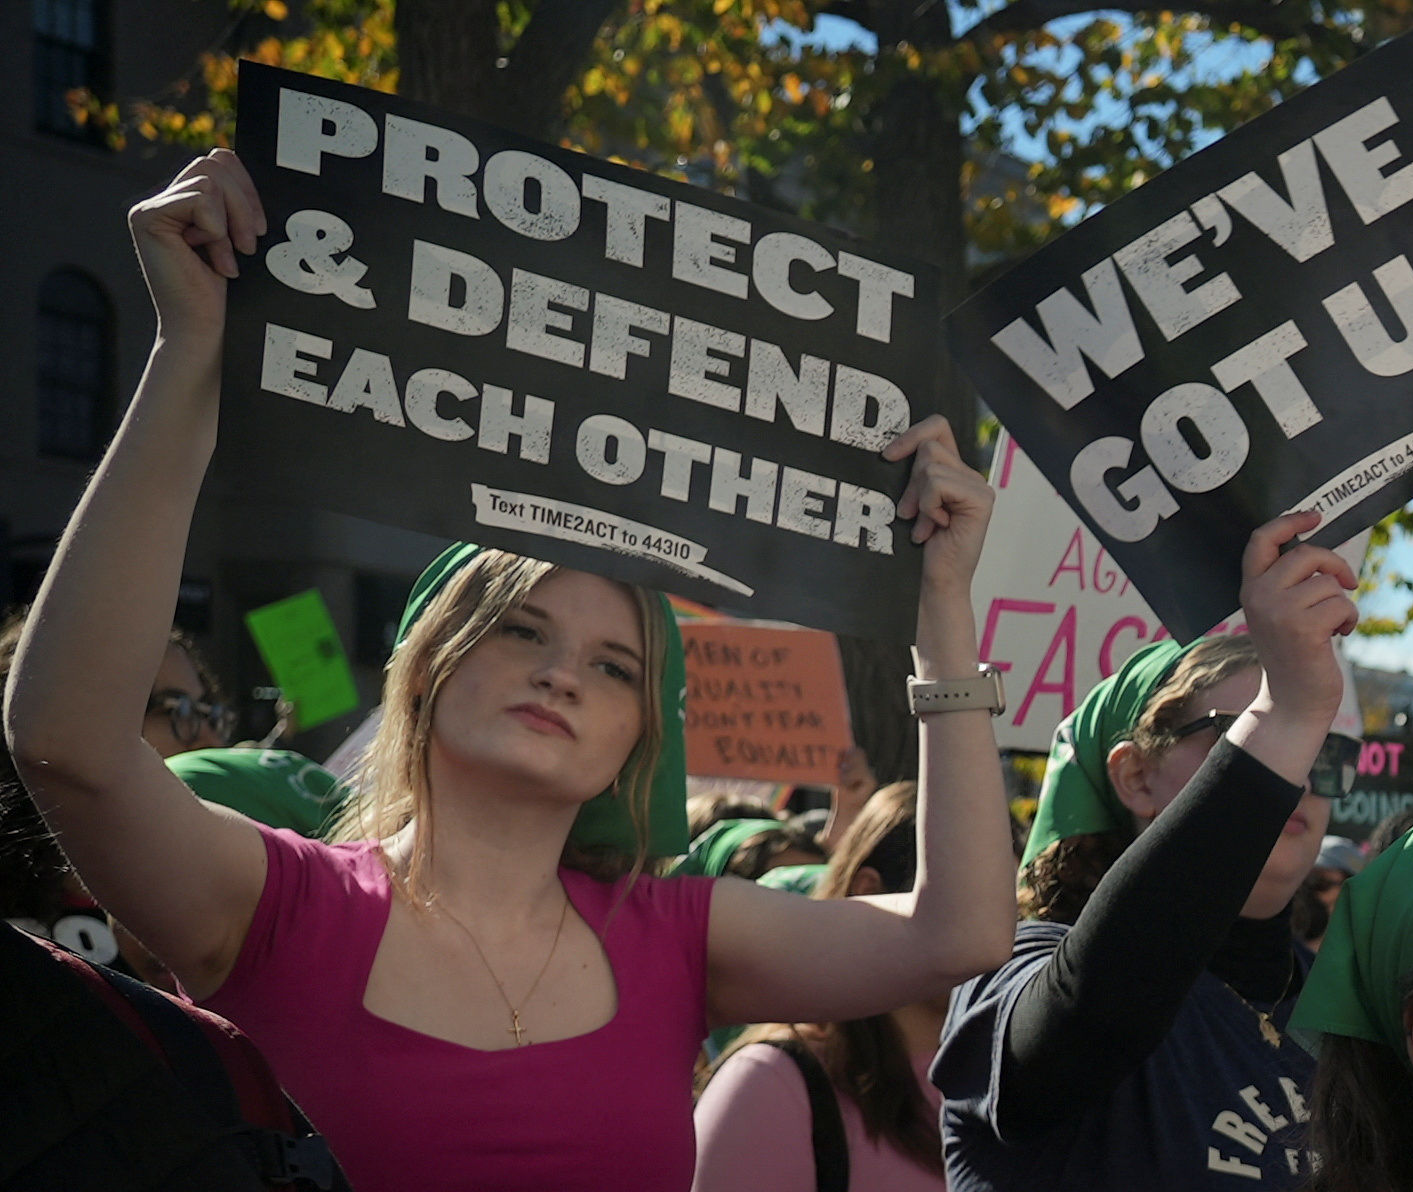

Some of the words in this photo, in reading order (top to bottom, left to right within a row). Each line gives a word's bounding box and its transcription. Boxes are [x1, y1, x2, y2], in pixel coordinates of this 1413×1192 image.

[275, 87, 914, 344] PROTECT
[260, 322, 556, 465] EACH
[575, 413, 896, 556] OTHER
[264, 209, 377, 309] &
[407, 239, 911, 453] DEFEND
[1068, 320, 1325, 543] GOT
[489, 493, 526, 518] Text
[529, 503, 619, 541] TIME2ACT
[622, 529, 638, 547] to
[641, 534, 691, 561] 44310
[1322, 457, 1390, 507] TIME2ACT
[1390, 453, 1405, 467] to
